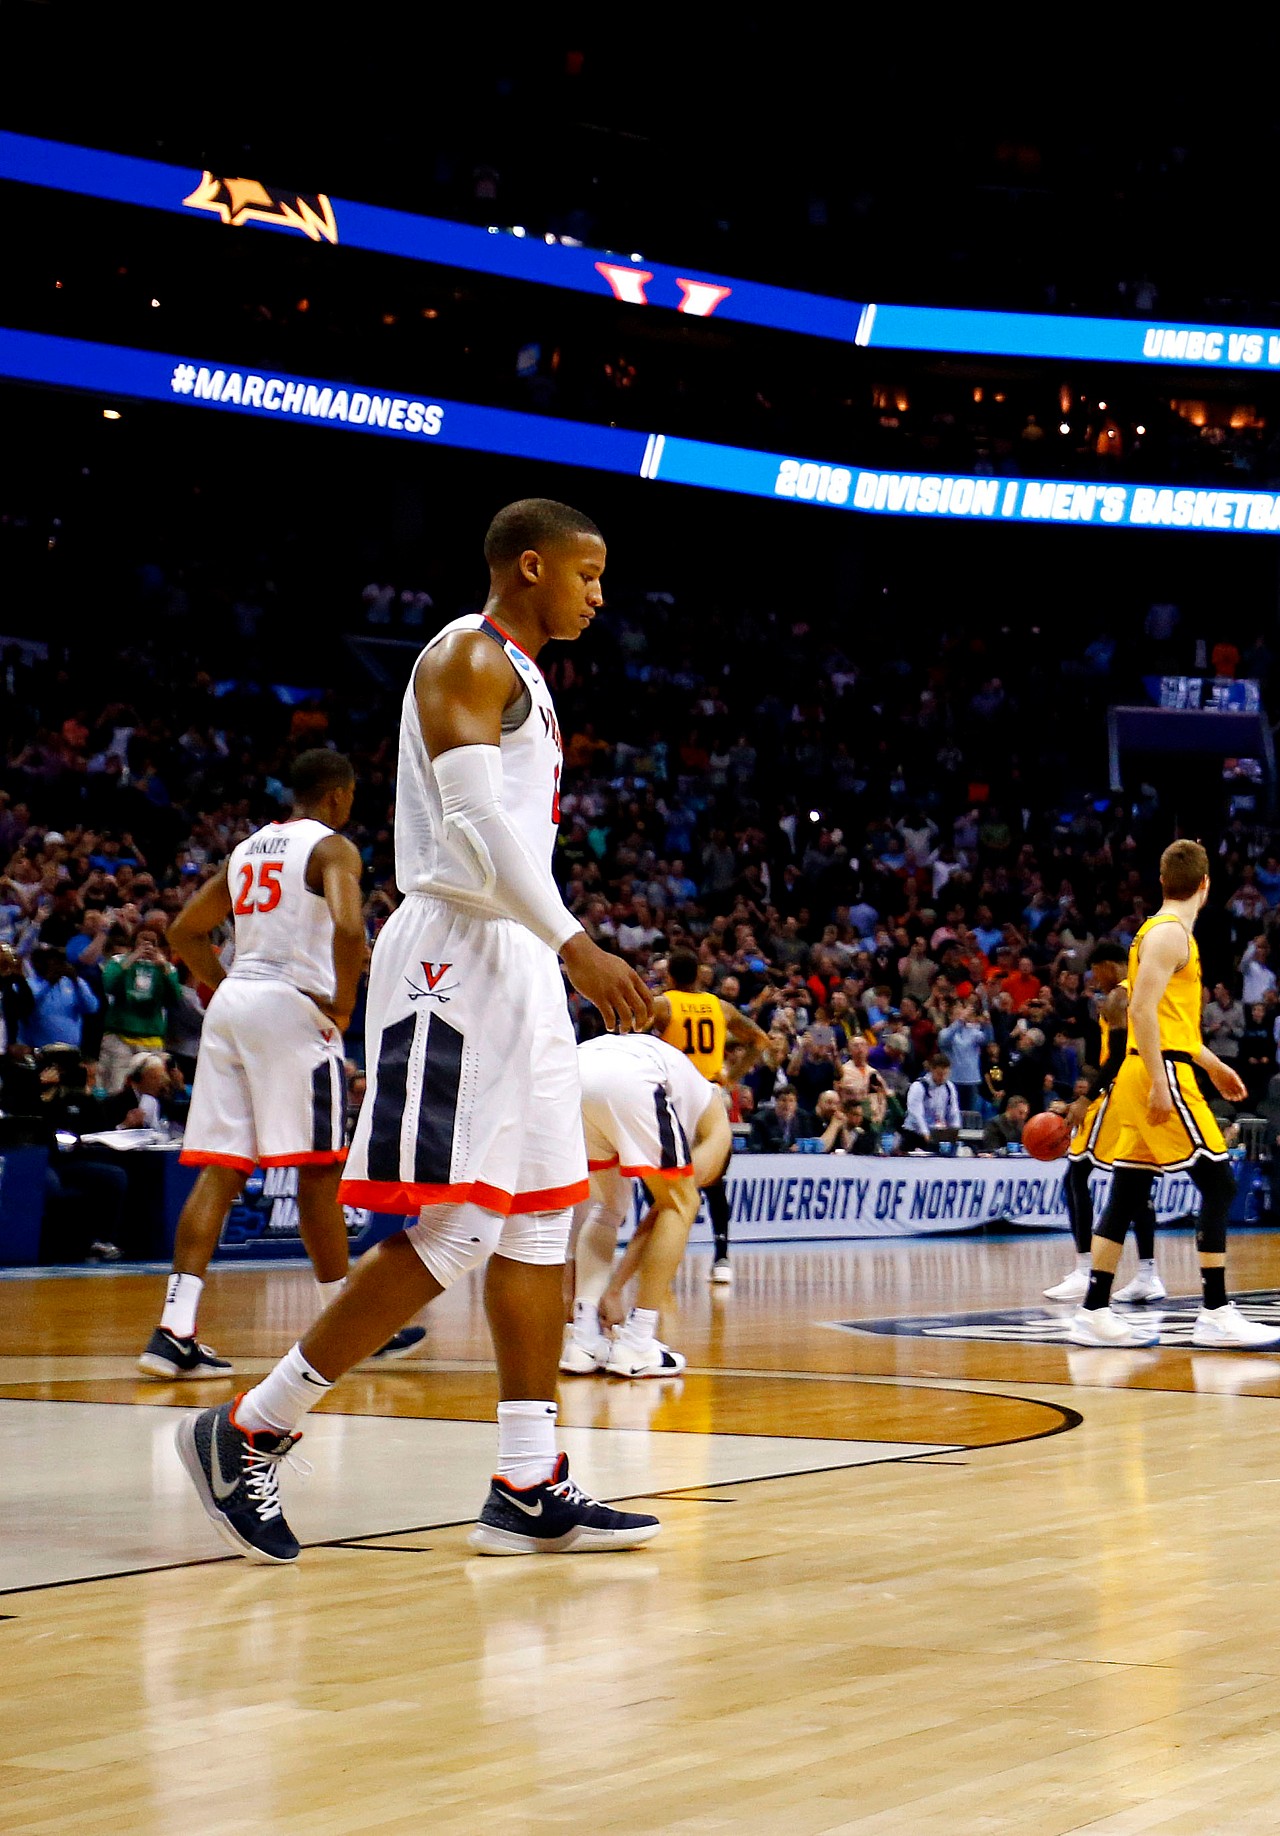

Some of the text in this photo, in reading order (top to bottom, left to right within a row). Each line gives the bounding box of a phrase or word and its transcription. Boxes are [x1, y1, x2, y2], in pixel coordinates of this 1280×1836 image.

[1143, 328, 1224, 361] UMBC
[1227, 333, 1264, 363] VS
[171, 363, 445, 436] #MARCHMADNESS
[774, 459, 852, 505] 2018
[853, 472, 999, 517] DIVISION
[1001, 481, 1018, 517] I
[1021, 482, 1127, 523] MEN'S
[234, 861, 284, 915] 25
[683, 1017, 715, 1054] 10
[724, 1177, 869, 1222] UNIVERSITY
[875, 1179, 907, 1222] OF
[910, 1178, 989, 1221] NORTH
[988, 1178, 1069, 1217] CAROLIN
